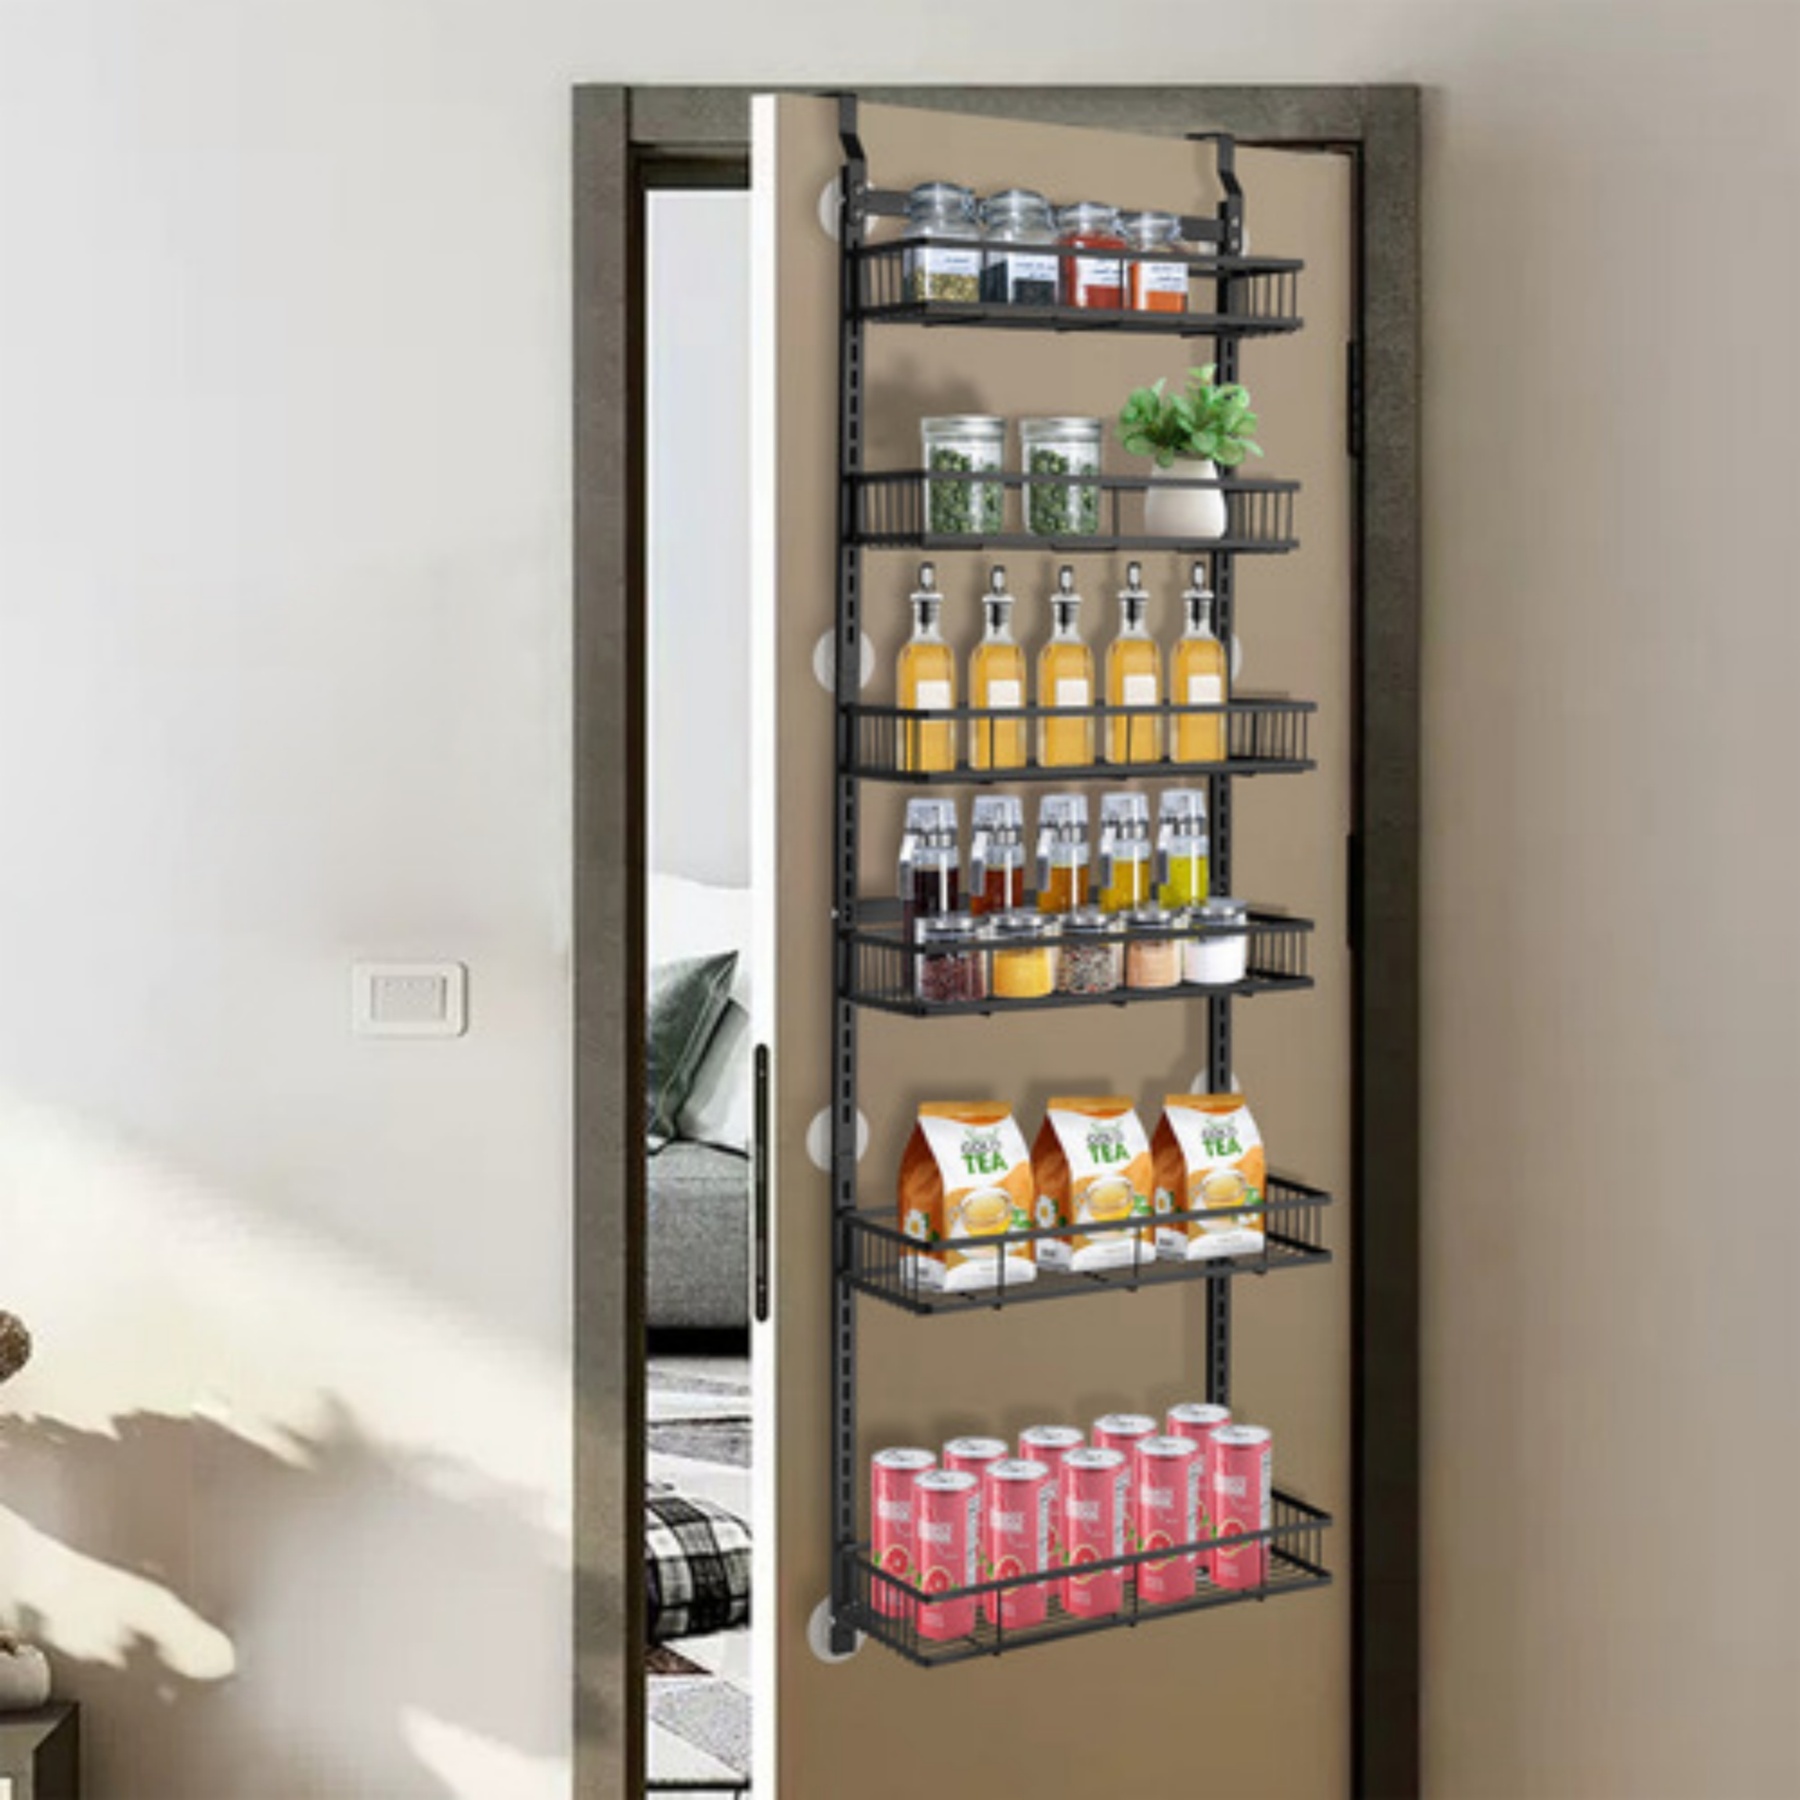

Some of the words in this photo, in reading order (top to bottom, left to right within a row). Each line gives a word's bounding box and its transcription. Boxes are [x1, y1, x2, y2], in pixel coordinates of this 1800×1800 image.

[1086, 1143, 1131, 1164] TEA
[1202, 1137, 1243, 1158] TEA
[961, 1152, 1009, 1174] TEA
